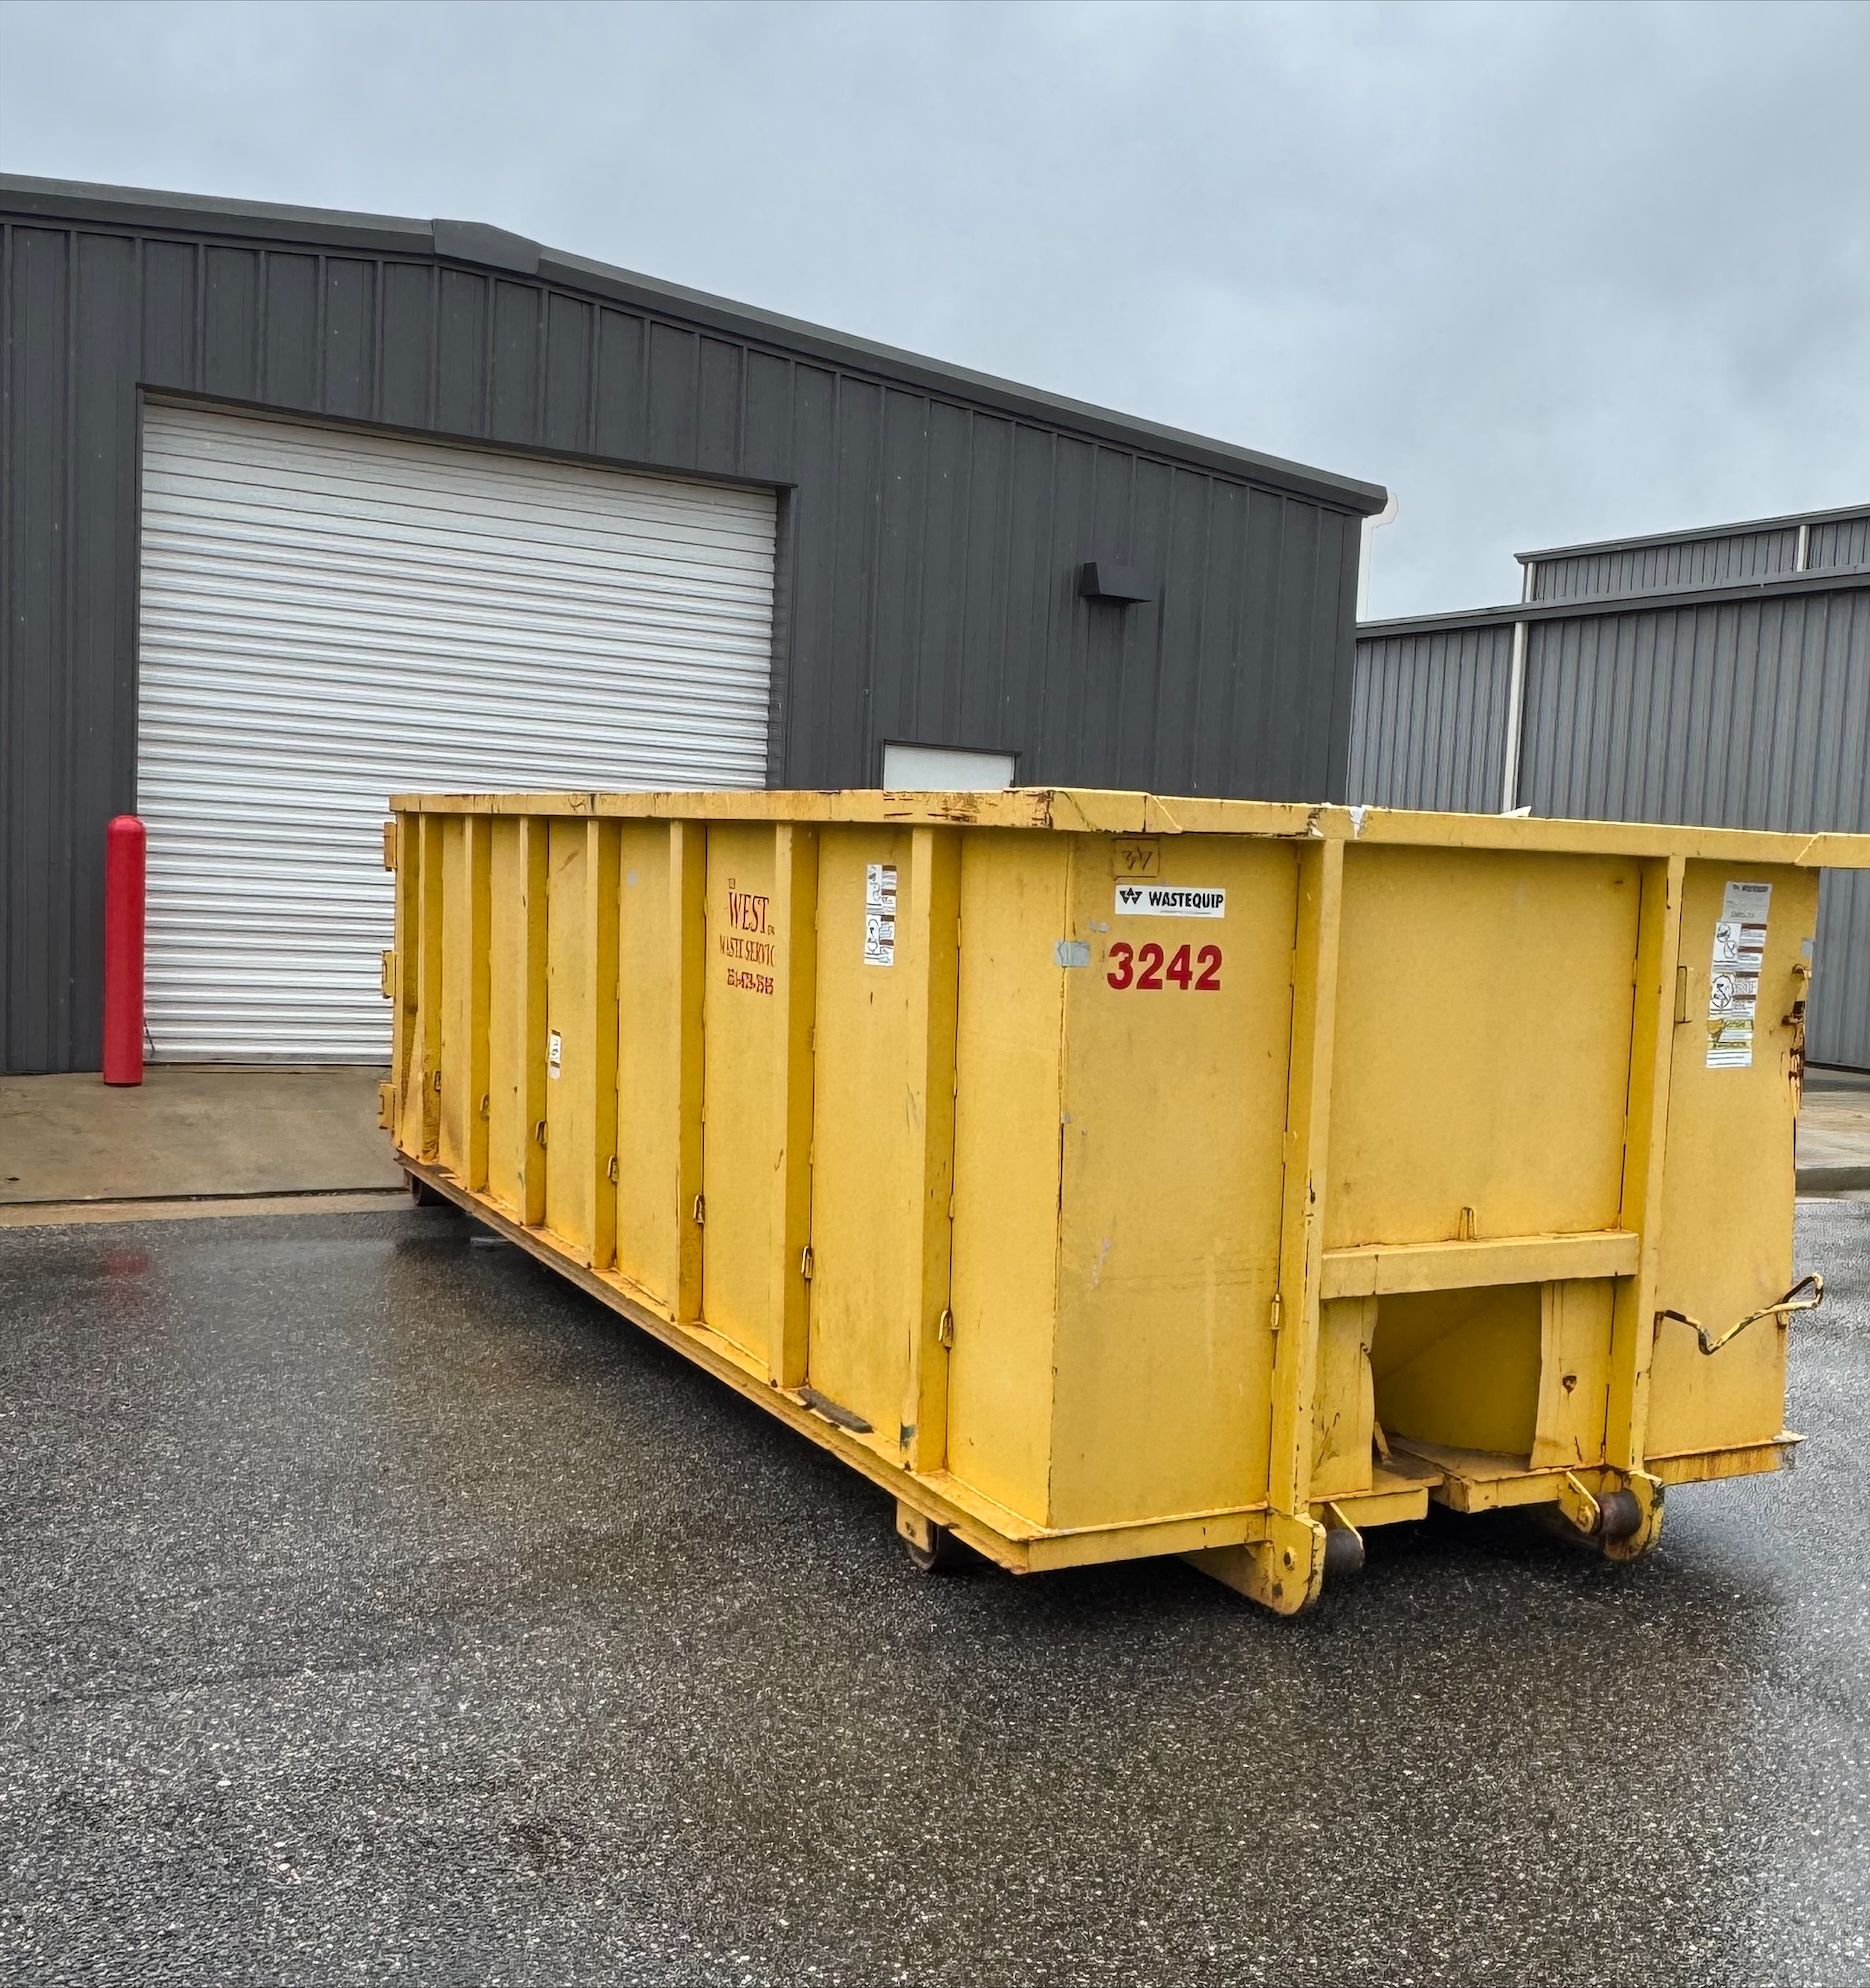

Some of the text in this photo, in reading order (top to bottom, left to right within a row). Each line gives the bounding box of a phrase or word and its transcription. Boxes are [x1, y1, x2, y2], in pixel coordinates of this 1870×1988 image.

[728, 891, 770, 934] WEST
[1148, 890, 1224, 909] WASTEQUIP
[1106, 941, 1223, 991] 3242
